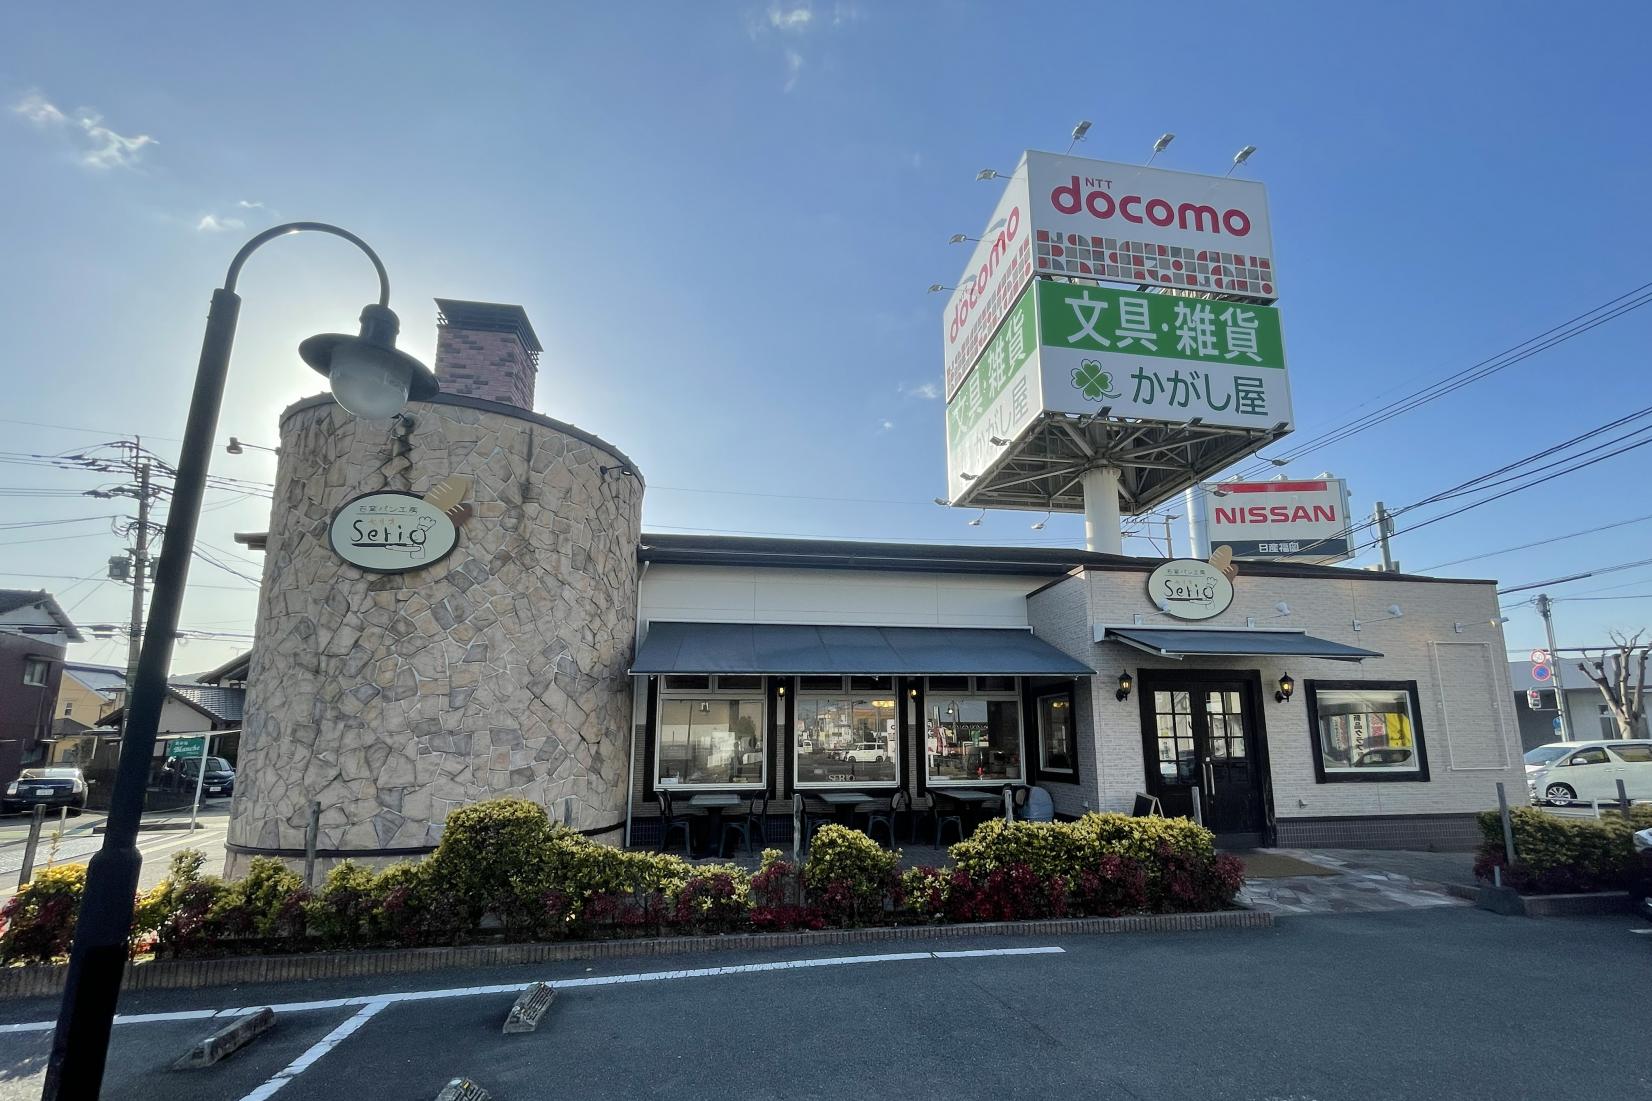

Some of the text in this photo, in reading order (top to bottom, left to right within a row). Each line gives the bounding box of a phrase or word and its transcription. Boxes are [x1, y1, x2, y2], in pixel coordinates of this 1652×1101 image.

[1085, 176, 1113, 190] NTT
[1051, 175, 1251, 237] docomo
[949, 206, 1020, 345] docomo
[1064, 290, 1264, 362] 文具・雑貨
[1131, 366, 1269, 417] かがし屋
[351, 519, 427, 545] Serio
[1215, 505, 1336, 525] NISSAN
[1164, 579, 1214, 599] Serio
